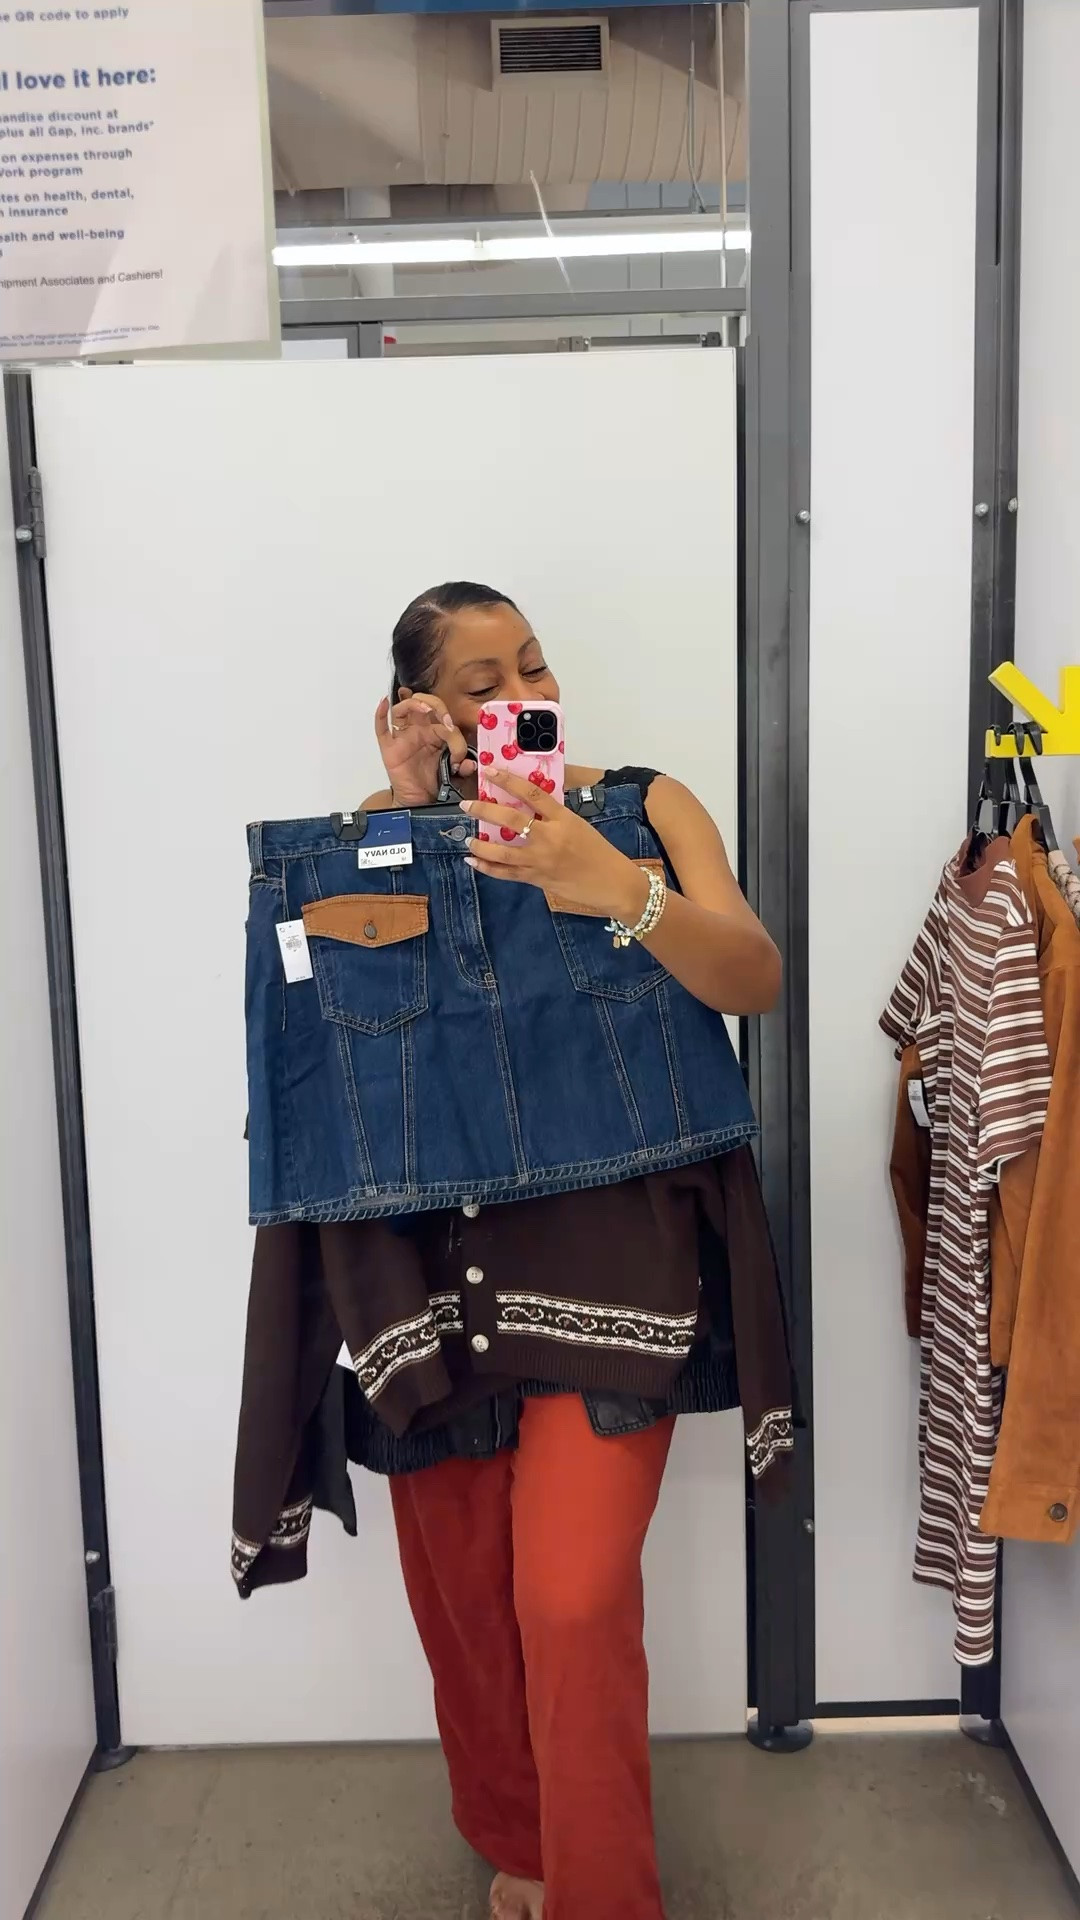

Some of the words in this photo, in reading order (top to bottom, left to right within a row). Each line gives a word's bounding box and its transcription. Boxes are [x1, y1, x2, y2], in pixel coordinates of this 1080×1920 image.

[15, 11, 34, 22] QR
[40, 10, 71, 21] code
[76, 9, 89, 20] to
[93, 7, 129, 19] apply
[16, 71, 66, 89] love
[73, 68, 90, 88] it
[97, 67, 156, 87] here:
[48, 110, 102, 122] discount
[106, 109, 119, 120] at
[29, 126, 44, 137] all
[48, 126, 77, 138] Gap,
[1, 154, 17, 163] on
[21, 152, 79, 164] expenses
[84, 149, 132, 162] through
[30, 166, 83, 179] program
[24, 193, 40, 203] on
[44, 190, 87, 203] health,
[91, 188, 135, 200] dental,
[9, 206, 69, 218] insurance
[32, 231, 55, 241] and
[59, 228, 125, 242] well-being
[40, 276, 95, 288] Associates
[97, 274, 116, 285] and
[117, 269, 164, 283] Cashiers!
